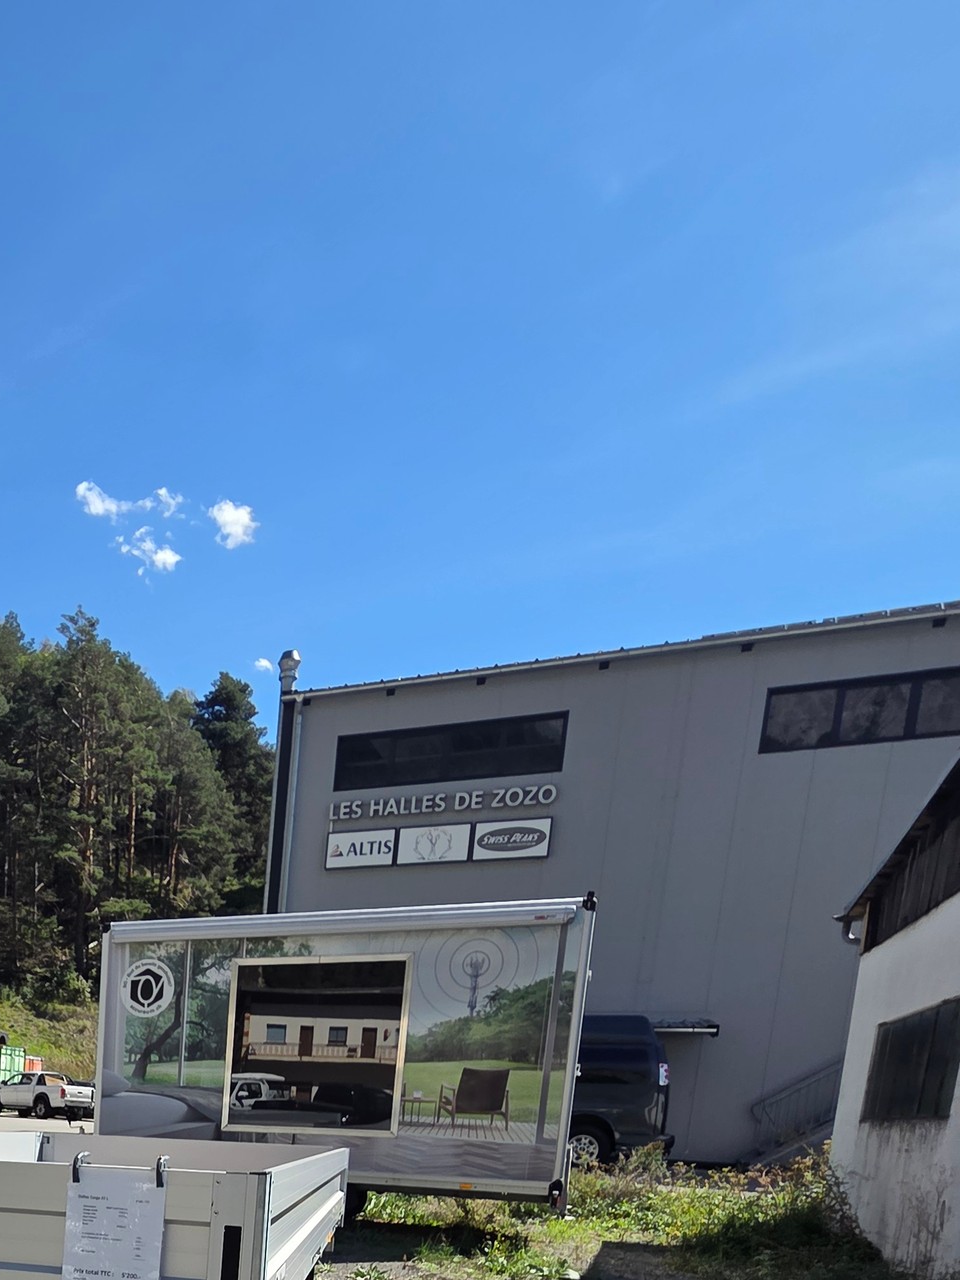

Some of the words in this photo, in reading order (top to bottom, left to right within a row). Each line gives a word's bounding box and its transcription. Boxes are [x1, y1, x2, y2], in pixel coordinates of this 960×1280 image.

[329, 800, 362, 820] LES
[369, 793, 446, 817] HALLES
[454, 791, 484, 810] DE
[491, 784, 557, 808] ZOZO
[346, 839, 392, 857] ALTIS
